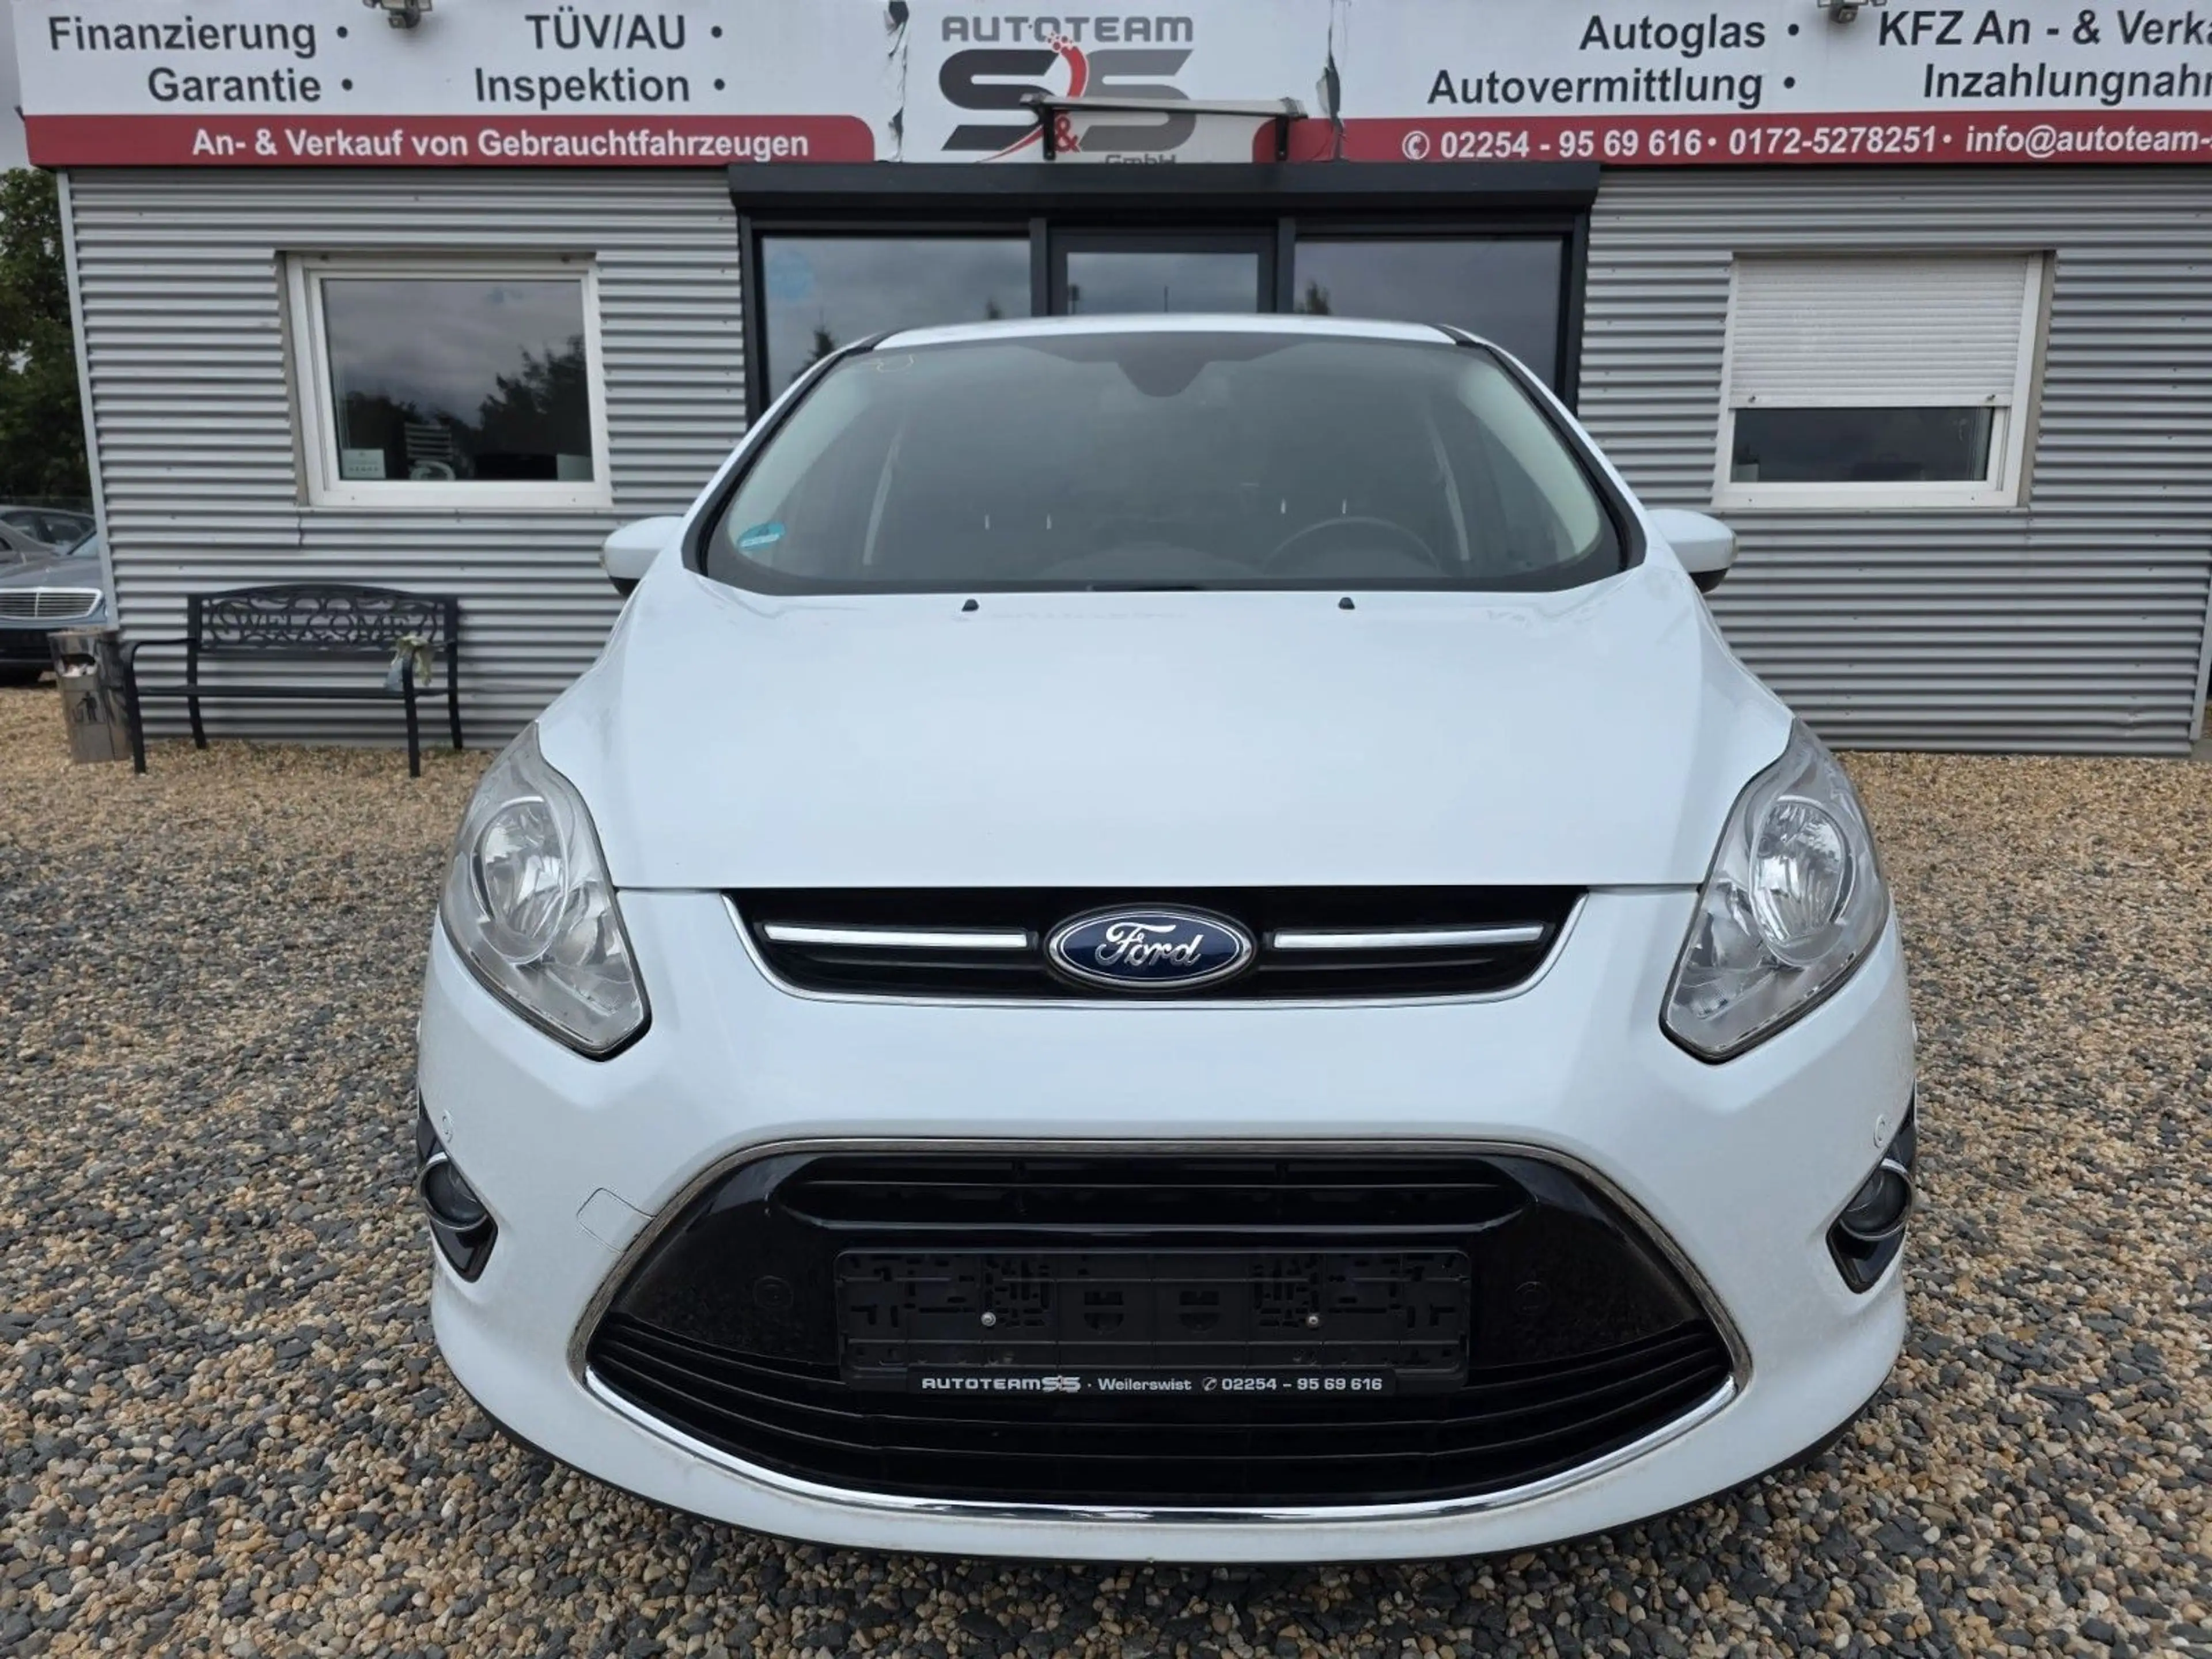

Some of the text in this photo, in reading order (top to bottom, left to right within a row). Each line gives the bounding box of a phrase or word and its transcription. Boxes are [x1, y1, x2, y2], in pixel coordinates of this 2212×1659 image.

[48, 15, 316, 59] Finanzierung
[525, 6, 685, 50] TÜV/AU
[942, 16, 1193, 41] AUTOTEAM
[1579, 14, 1766, 58] Autoglas
[1879, 10, 1964, 46] KFZ
[1974, 10, 2031, 45] An
[2073, 10, 2100, 45] &
[2117, 10, 2212, 45] Verk
[148, 67, 321, 102] Garantie
[475, 67, 690, 110] Inspektion
[1427, 67, 1763, 109] Autovermittlung
[192, 129, 808, 161] An- & Verkauf von Gebrauchtfahrzeugen
[1441, 131, 1529, 158] 02254
[1559, 131, 1594, 157] 95
[1604, 130, 1639, 156] 69
[1649, 130, 1702, 156] 616
[1729, 126, 1936, 155] 0172-5278251
[1966, 125, 2212, 158] info@autoteam-
[1094, 922, 1204, 965] Ford
[1097, 1378, 1192, 1391] Weilerswist
[1222, 1378, 1277, 1391] 02254
[1297, 1378, 1320, 1390] 95
[1324, 1378, 1346, 1391] 69
[1351, 1378, 1382, 1391] 616
